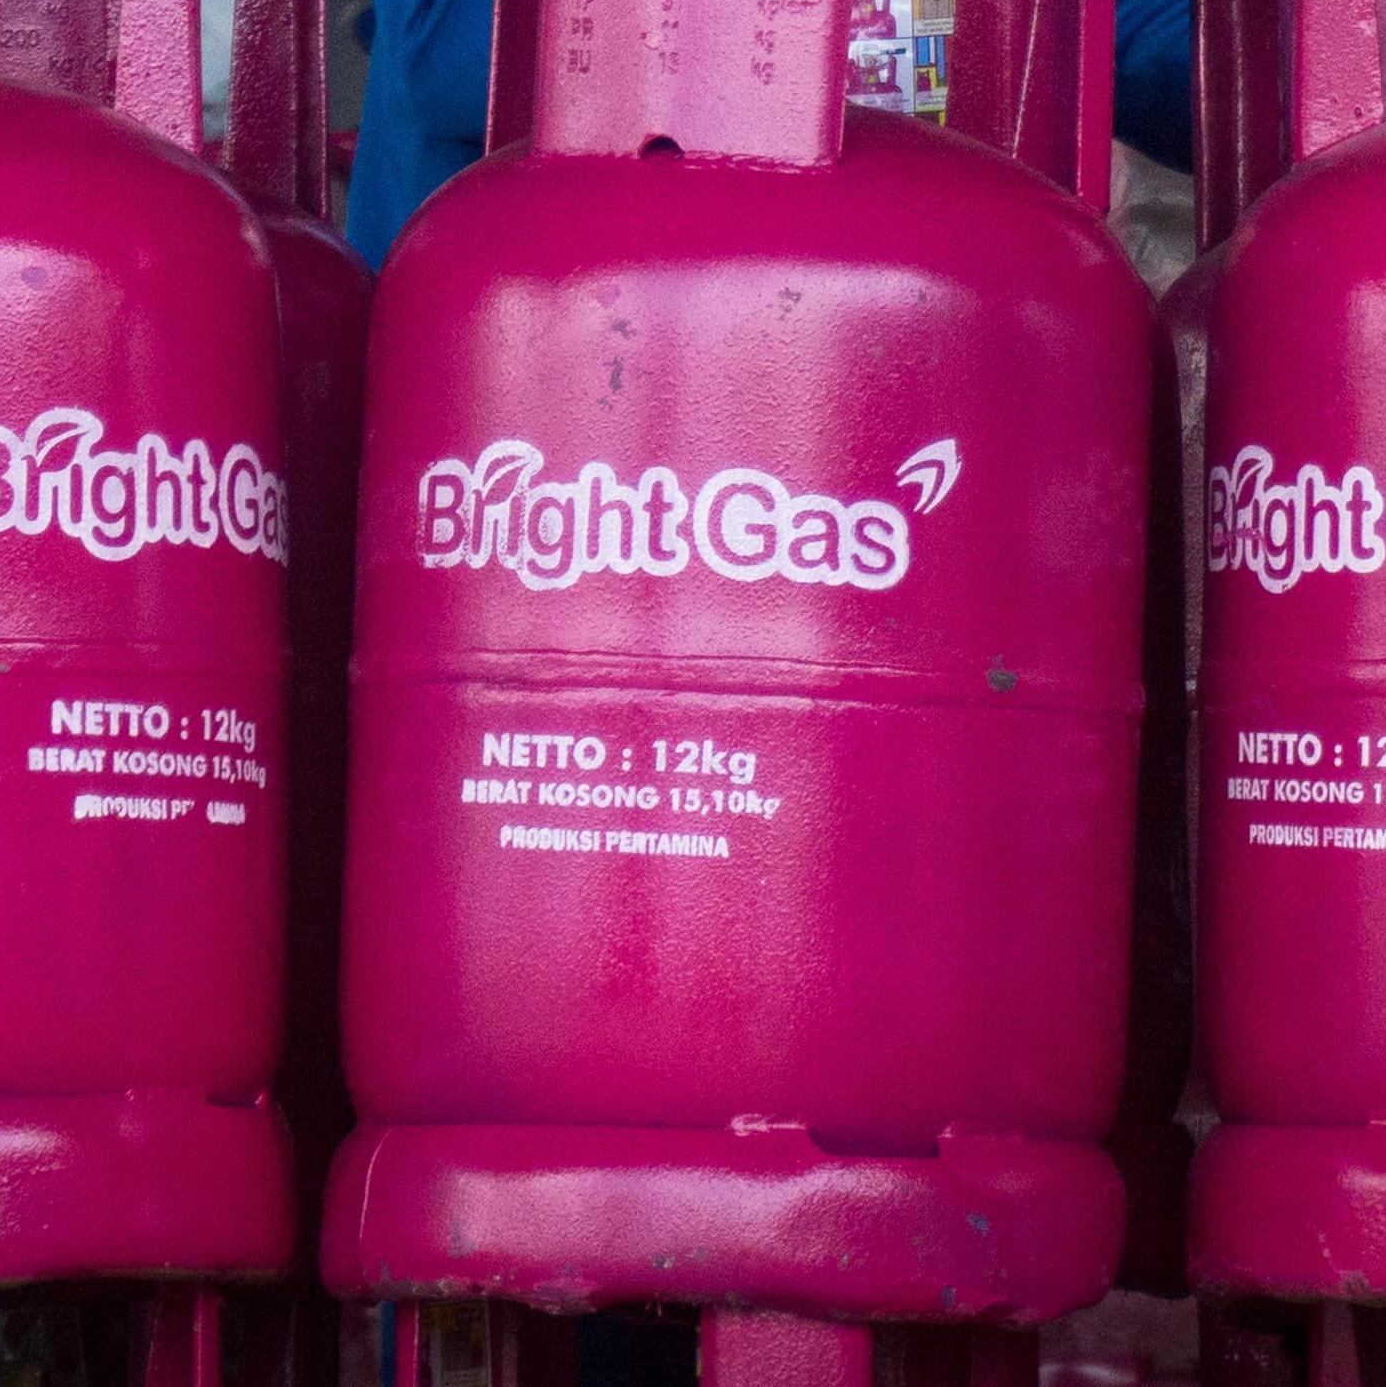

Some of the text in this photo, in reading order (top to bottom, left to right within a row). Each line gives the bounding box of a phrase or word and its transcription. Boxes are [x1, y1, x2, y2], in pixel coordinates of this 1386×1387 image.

[218, 442, 289, 567] Ga
[418, 440, 910, 591] Bright Gas
[50, 699, 170, 739] NETTO
[200, 708, 257, 754] 12kg
[27, 747, 268, 790] BERAT KOSONG 15,10kg
[481, 732, 607, 771] NETTO
[651, 738, 758, 785] 12kg
[1237, 731, 1323, 767] NETTO
[460, 778, 781, 821] BERAT KOSONG 15,10kg
[1226, 777, 1270, 801] BERAT
[1273, 778, 1365, 805] KOSONG
[499, 824, 730, 859] PRODUKSI PERTAMINA
[1248, 823, 1320, 846] PRODUKSI
